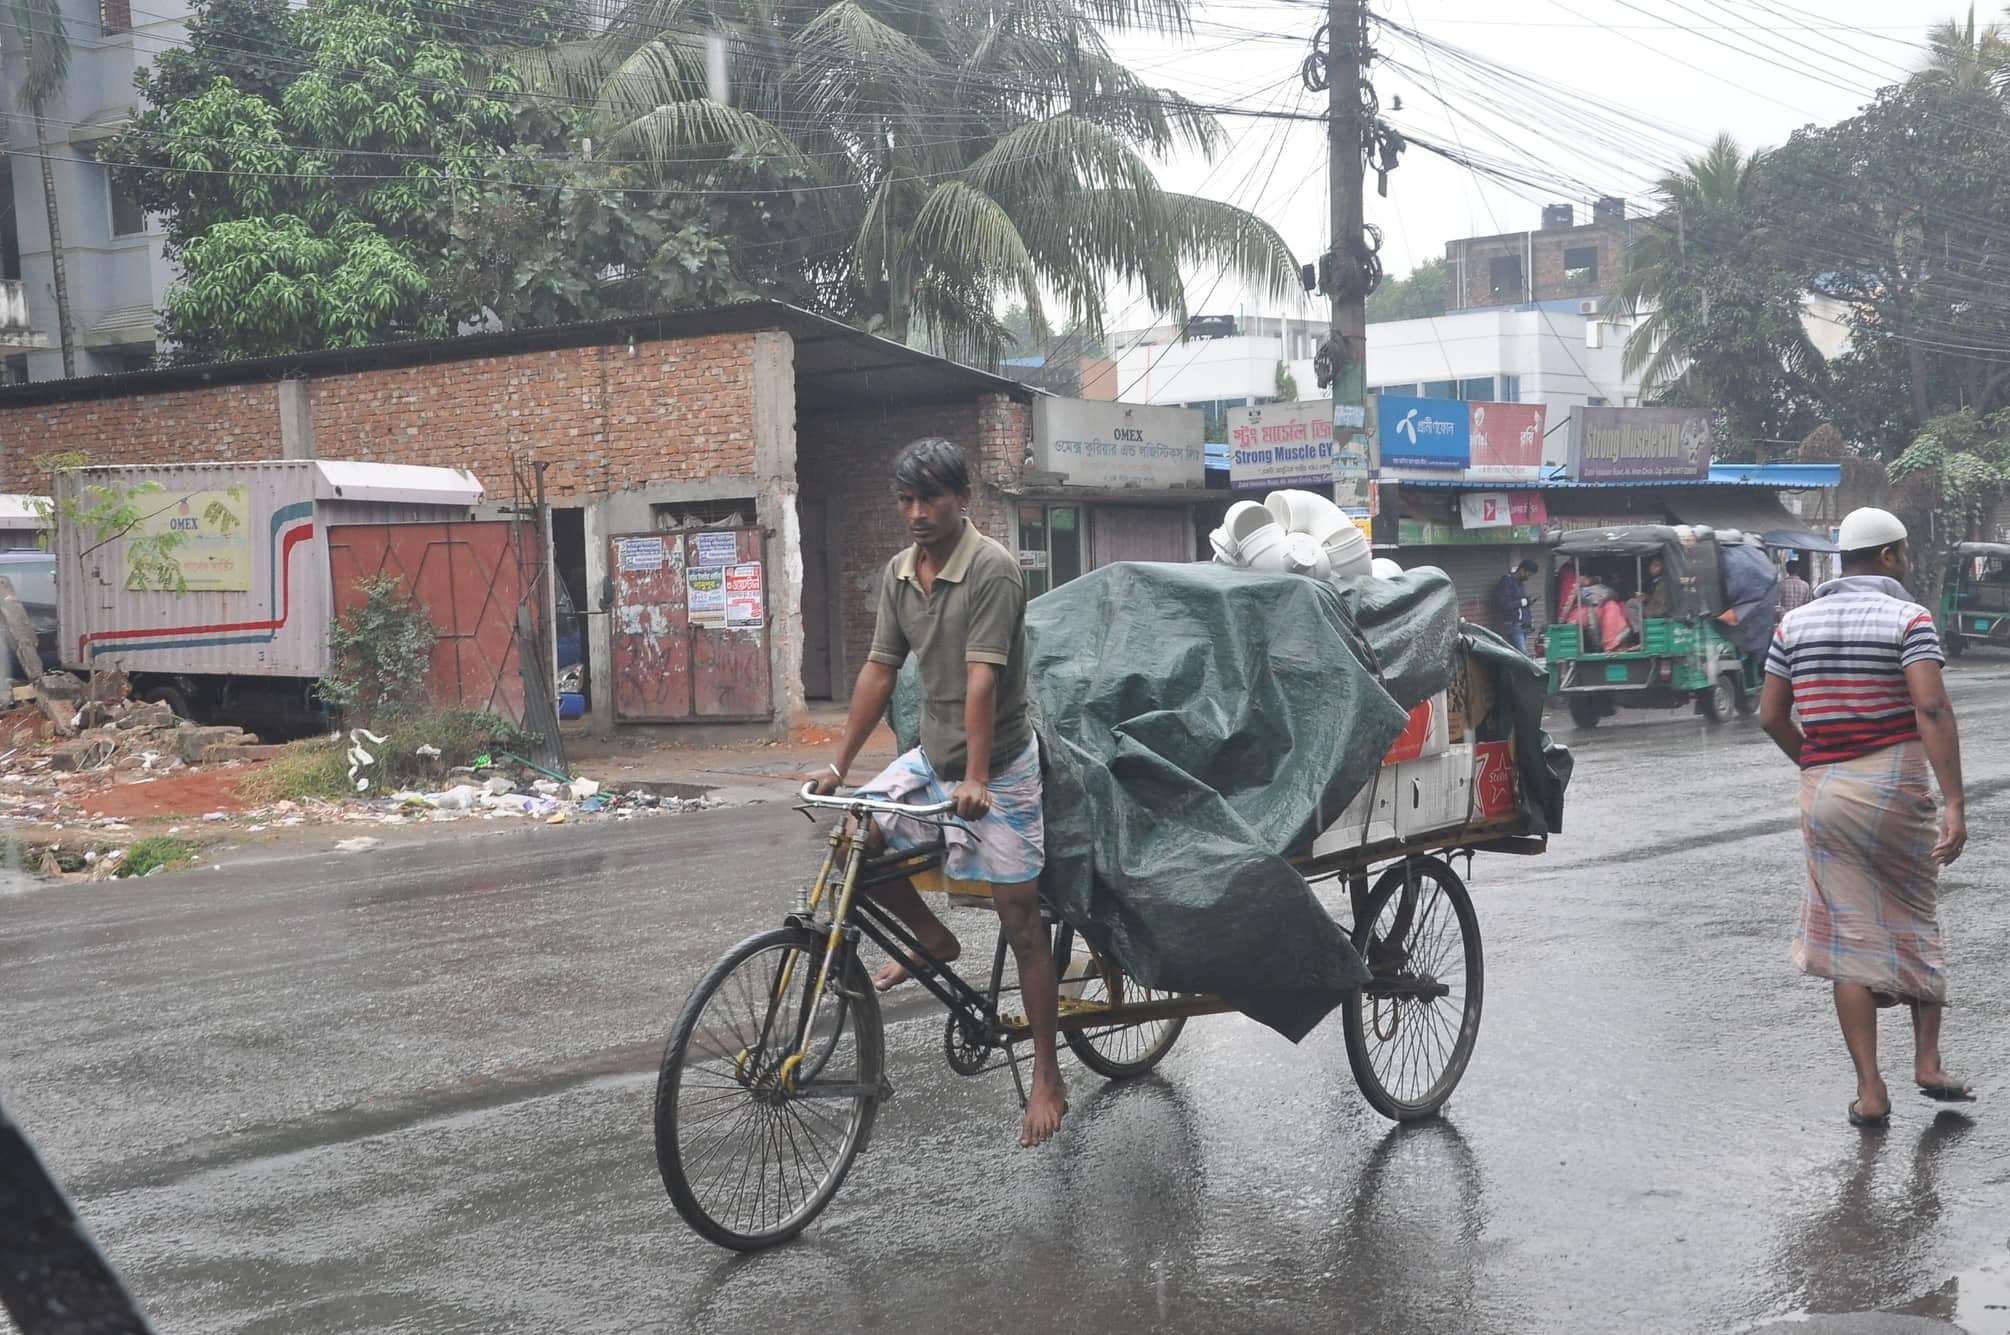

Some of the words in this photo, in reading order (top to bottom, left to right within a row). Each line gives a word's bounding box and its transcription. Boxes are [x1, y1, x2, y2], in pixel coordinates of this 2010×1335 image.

[1114, 428, 1143, 442] OMEX
[1586, 423, 1620, 463] Strong
[1620, 423, 1657, 458] Muscle
[1658, 423, 1680, 458] GYM
[1235, 448, 1272, 464] Strong
[1275, 444, 1316, 461] Muscle
[1319, 442, 1333, 457] GY
[170, 517, 198, 530] OMEX
